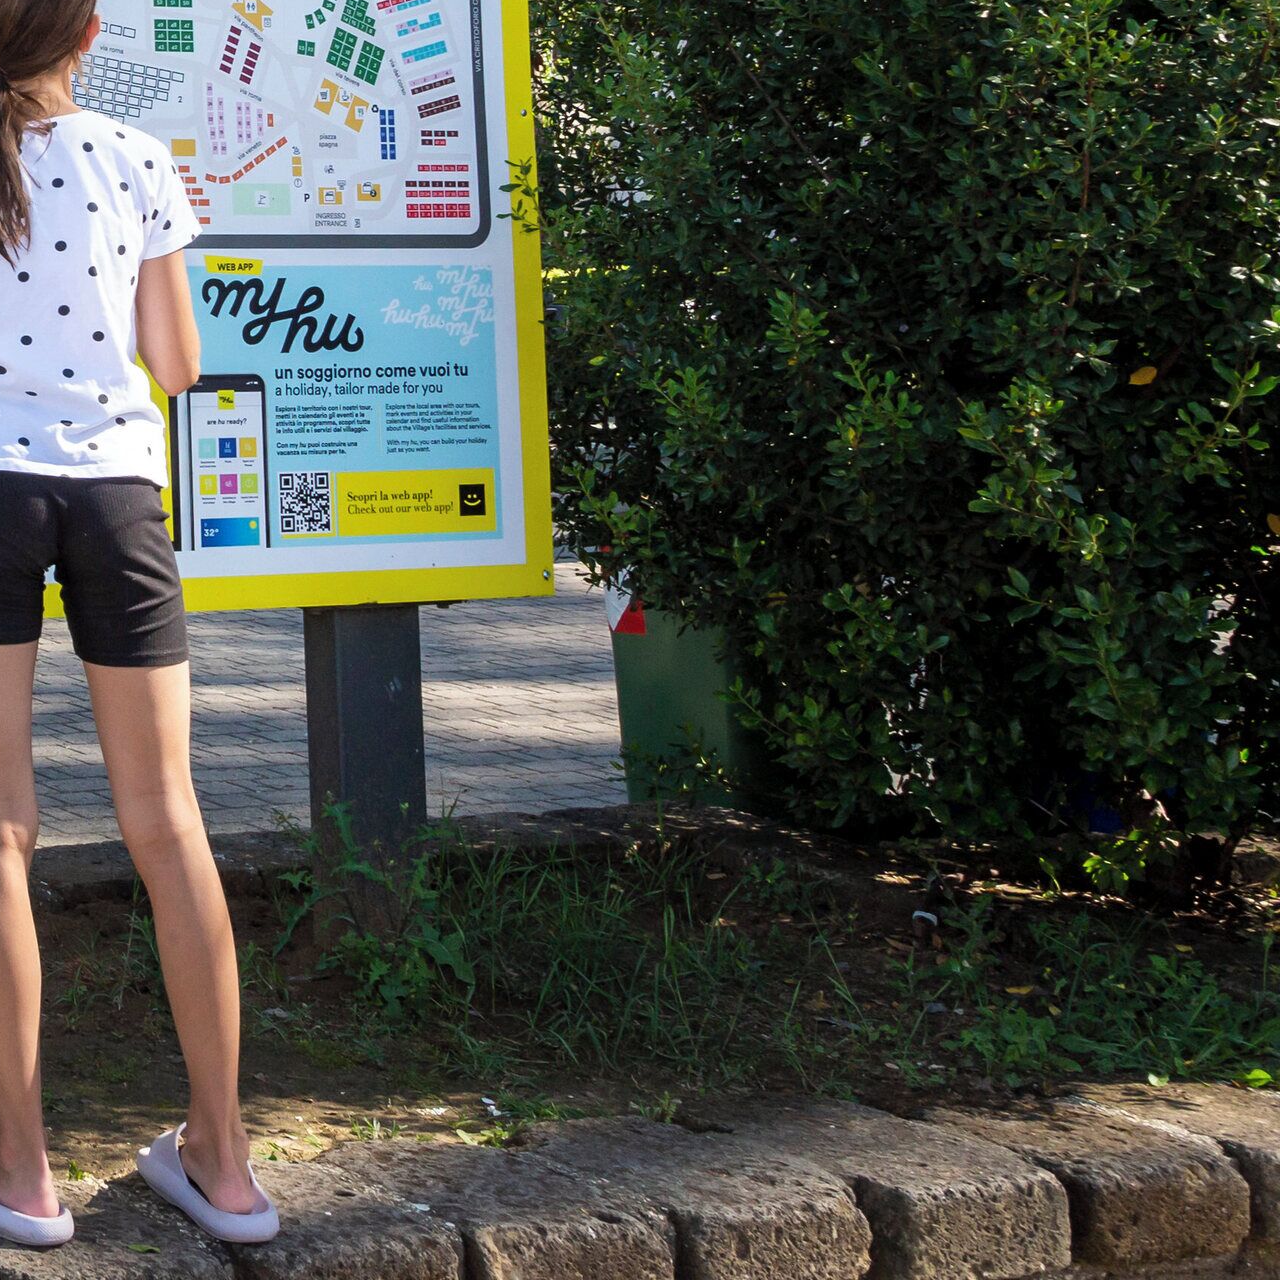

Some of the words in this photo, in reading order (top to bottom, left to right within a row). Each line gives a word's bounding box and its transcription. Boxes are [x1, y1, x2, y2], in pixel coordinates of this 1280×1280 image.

[472, 7, 481, 57] CRISTOFORO
[319, 133, 337, 141] piazza
[319, 140, 338, 148] spagna
[218, 263, 236, 271] WEB
[238, 262, 253, 271] APP
[275, 368, 292, 380] un
[298, 364, 372, 382] soggiorno
[376, 367, 416, 377] come
[420, 362, 450, 377] vuoi
[453, 363, 468, 376] tu
[275, 386, 281, 396] a
[286, 382, 331, 398] holiday,
[335, 382, 364, 395] tailor
[368, 382, 399, 394] made
[403, 381, 419, 394] for
[422, 384, 443, 396] you
[226, 418, 247, 426] ready?
[347, 491, 378, 504] Scopri
[380, 491, 389, 501] la
[391, 490, 410, 500] web
[412, 489, 433, 503] app!
[347, 503, 375, 514] Check
[379, 504, 394, 514] out
[396, 504, 412, 513] our
[414, 502, 433, 512] web
[434, 502, 454, 514] app!
